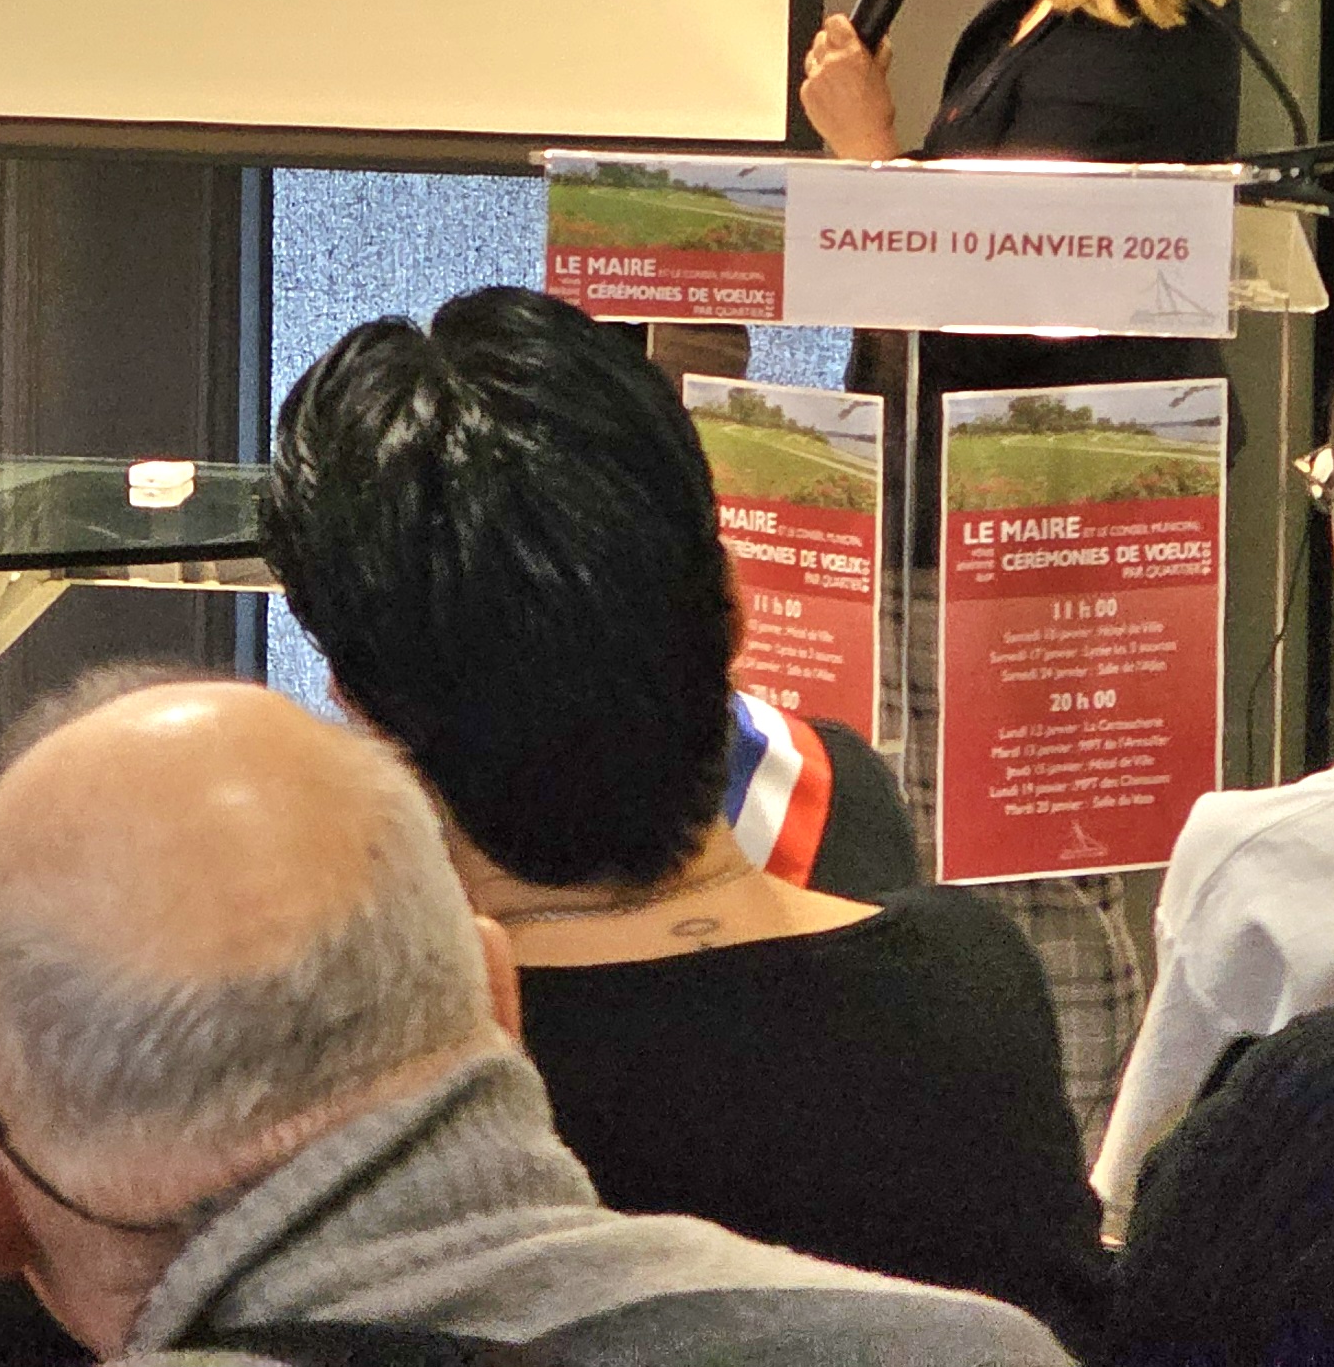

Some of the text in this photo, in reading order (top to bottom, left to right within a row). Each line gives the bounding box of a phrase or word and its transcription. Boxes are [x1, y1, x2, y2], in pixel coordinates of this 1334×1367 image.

[818, 229, 1190, 262] SAMEDI 10 JANVIER 2026
[555, 255, 581, 274] LE
[587, 257, 657, 276] MAIRE
[688, 288, 709, 301] DE
[963, 521, 994, 545] LE
[1000, 516, 1081, 543] MAIRE
[1001, 546, 1110, 571] CÉRÉMONIES
[1117, 545, 1140, 563] DE
